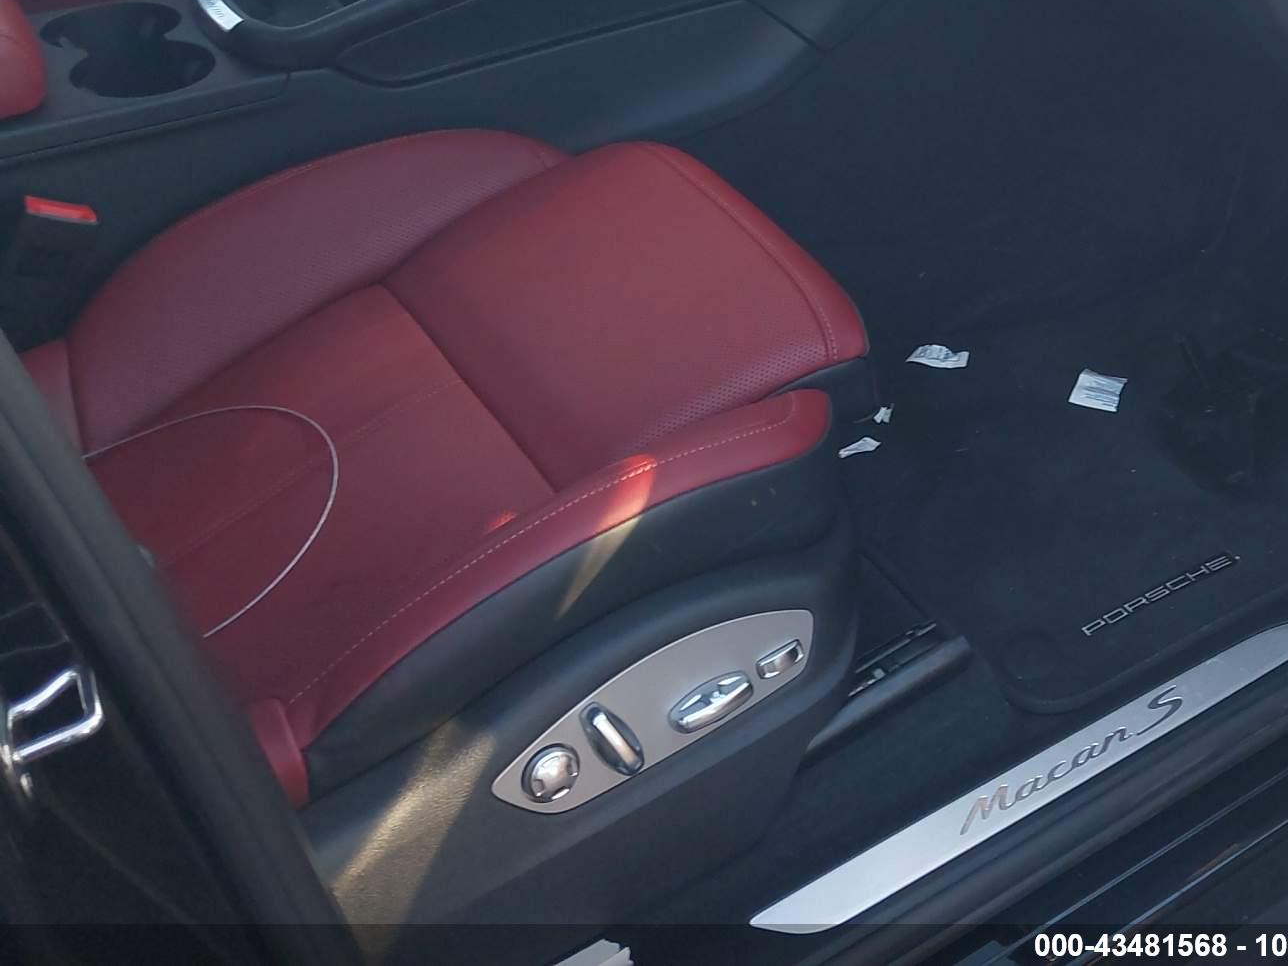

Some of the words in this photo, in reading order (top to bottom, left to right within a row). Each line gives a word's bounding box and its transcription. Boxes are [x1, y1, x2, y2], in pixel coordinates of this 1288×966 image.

[1081, 554, 1234, 636] PORSCHE
[959, 726, 1137, 836] Macan
[1133, 684, 1184, 737] S
